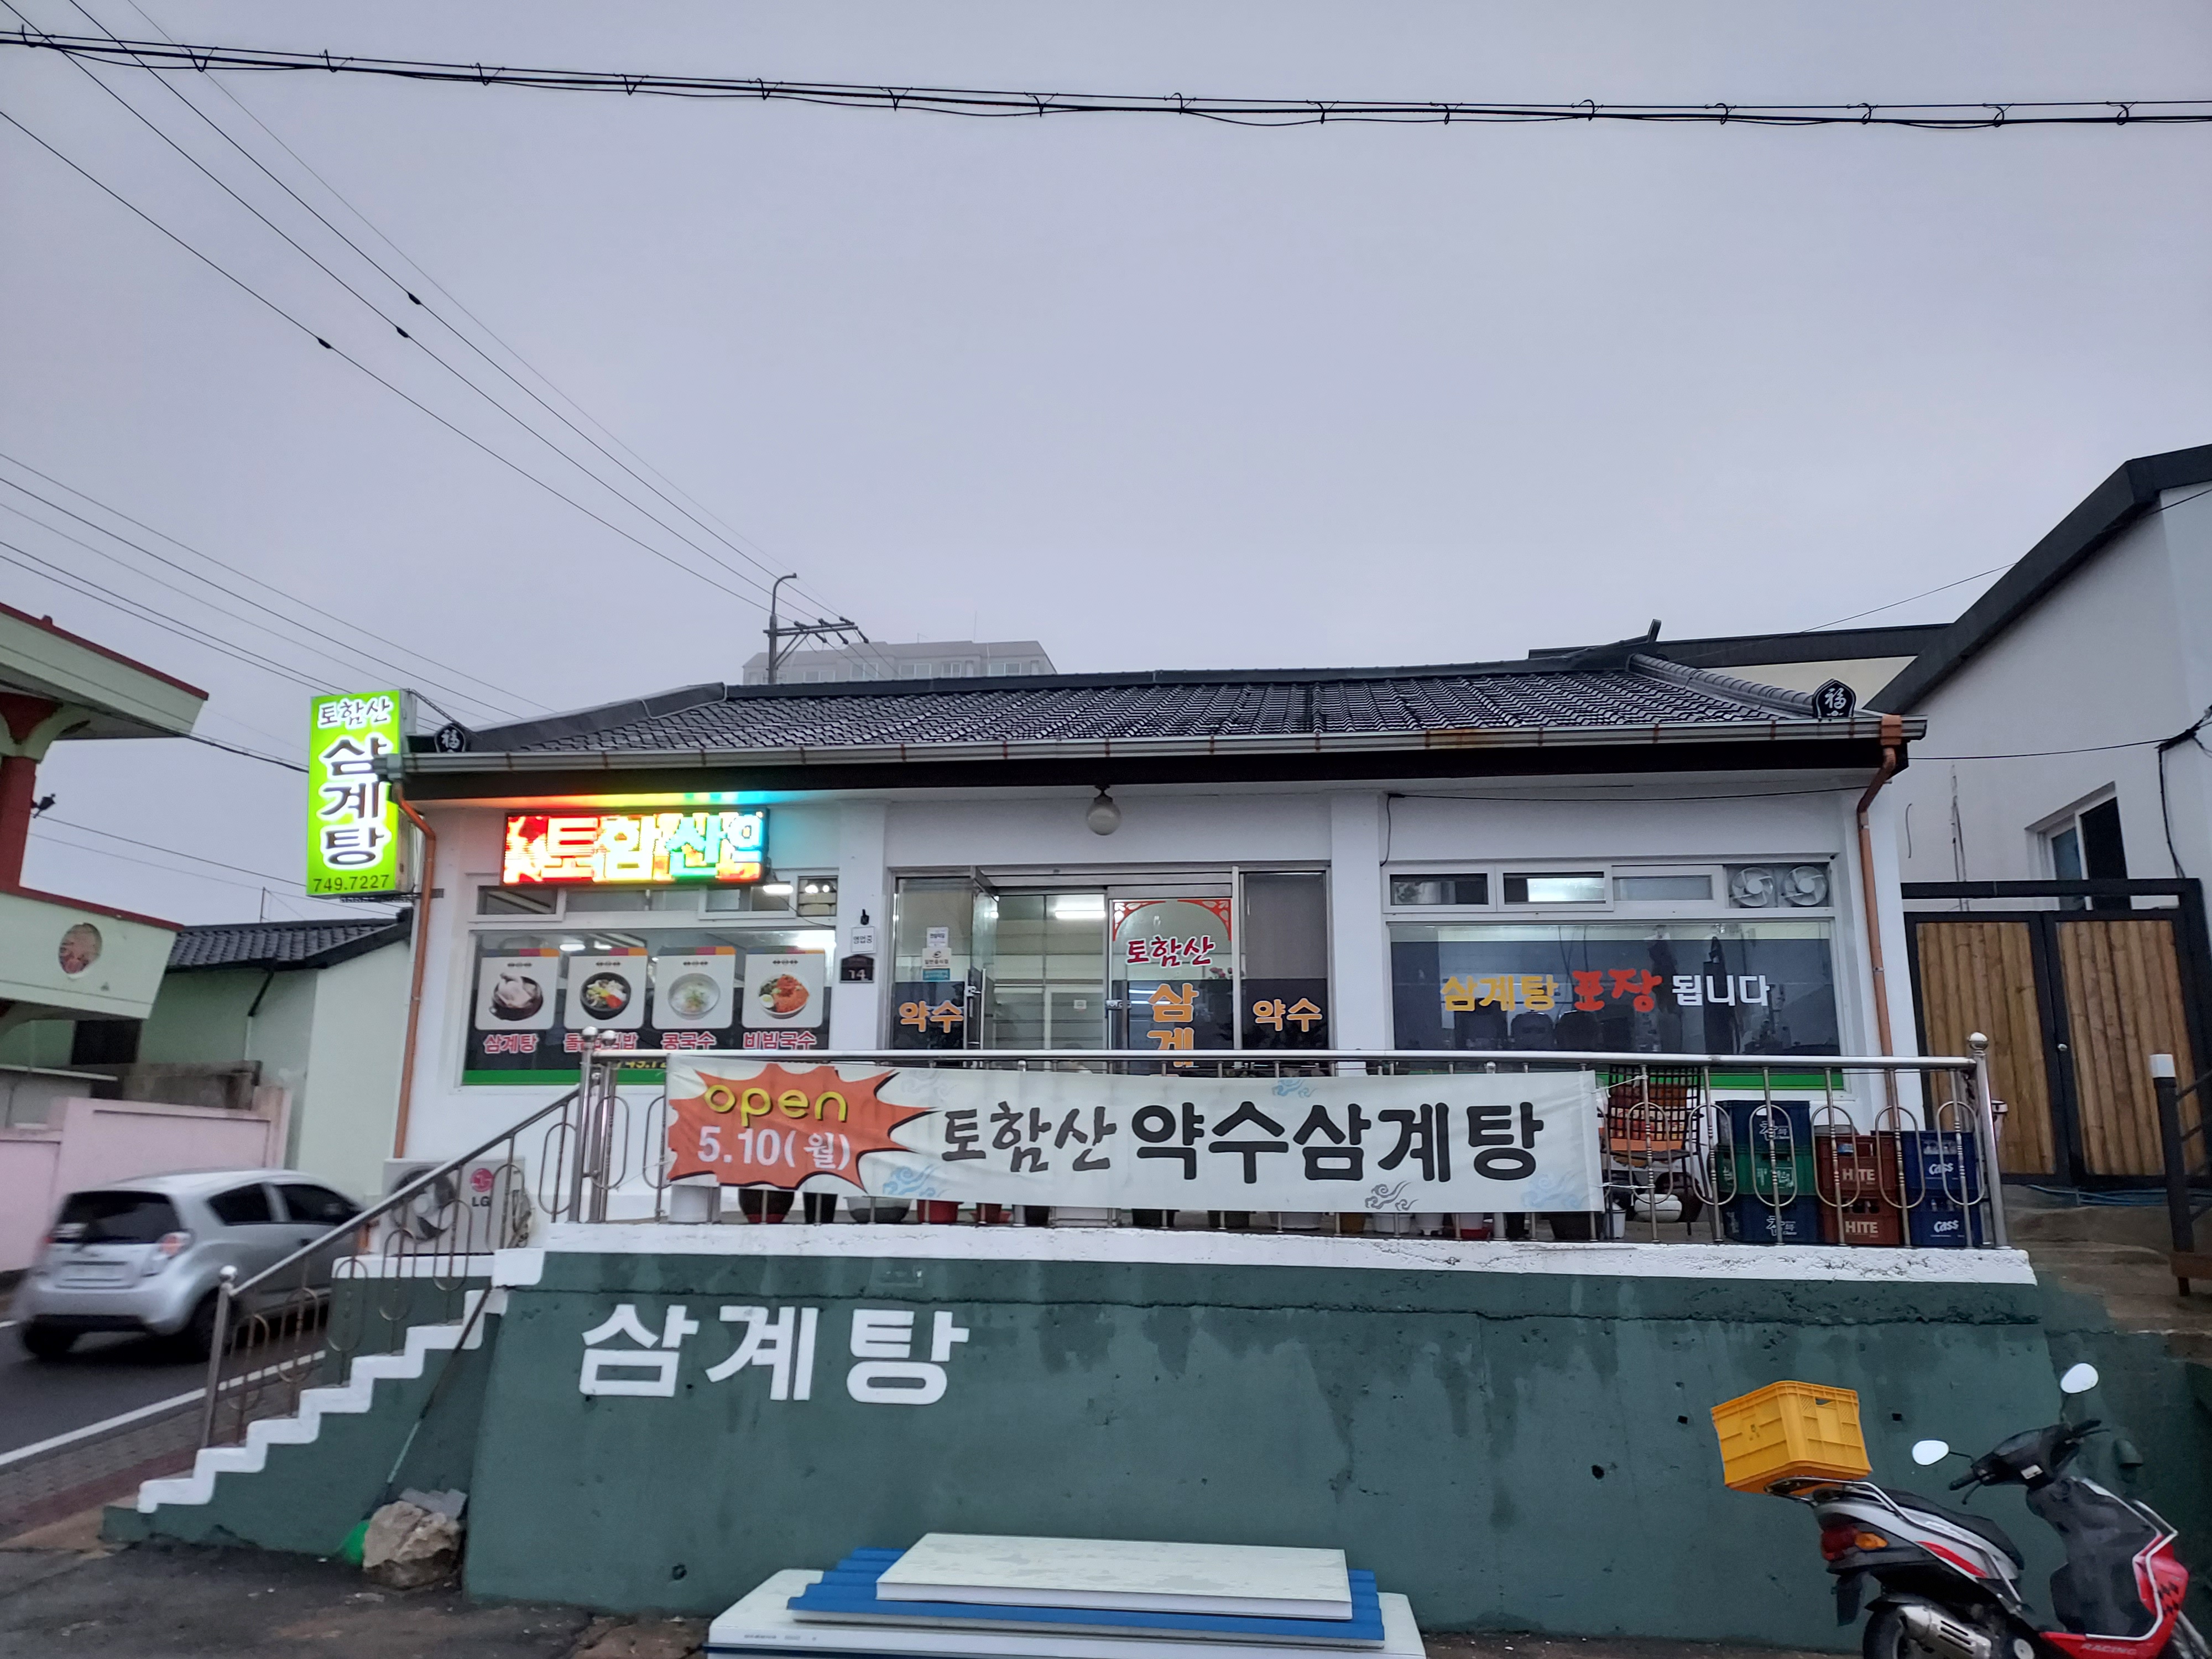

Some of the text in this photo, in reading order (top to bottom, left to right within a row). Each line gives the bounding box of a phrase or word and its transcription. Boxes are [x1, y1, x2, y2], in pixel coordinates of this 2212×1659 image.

[320, 698, 390, 726] 토함산
[320, 737, 388, 867] 삼계탕
[314, 875, 390, 891] 749.7227
[1126, 935, 1215, 967] 토함산
[848, 969, 867, 980] 14
[1440, 969, 1770, 1013] 삼계탕 포장 됩니다
[899, 1001, 963, 1032] 약수
[1253, 998, 1322, 1032] 약수
[483, 1033, 539, 1053] 삼계탕
[661, 1031, 717, 1050] 콩국수
[743, 1031, 817, 1050] 비빔국수
[1147, 983, 1199, 1077] 삼계
[705, 1085, 847, 1128] open
[942, 1101, 1117, 1173] 토함산
[1843, 1168, 1875, 1181] HTE
[1845, 1221, 1879, 1233] HITE
